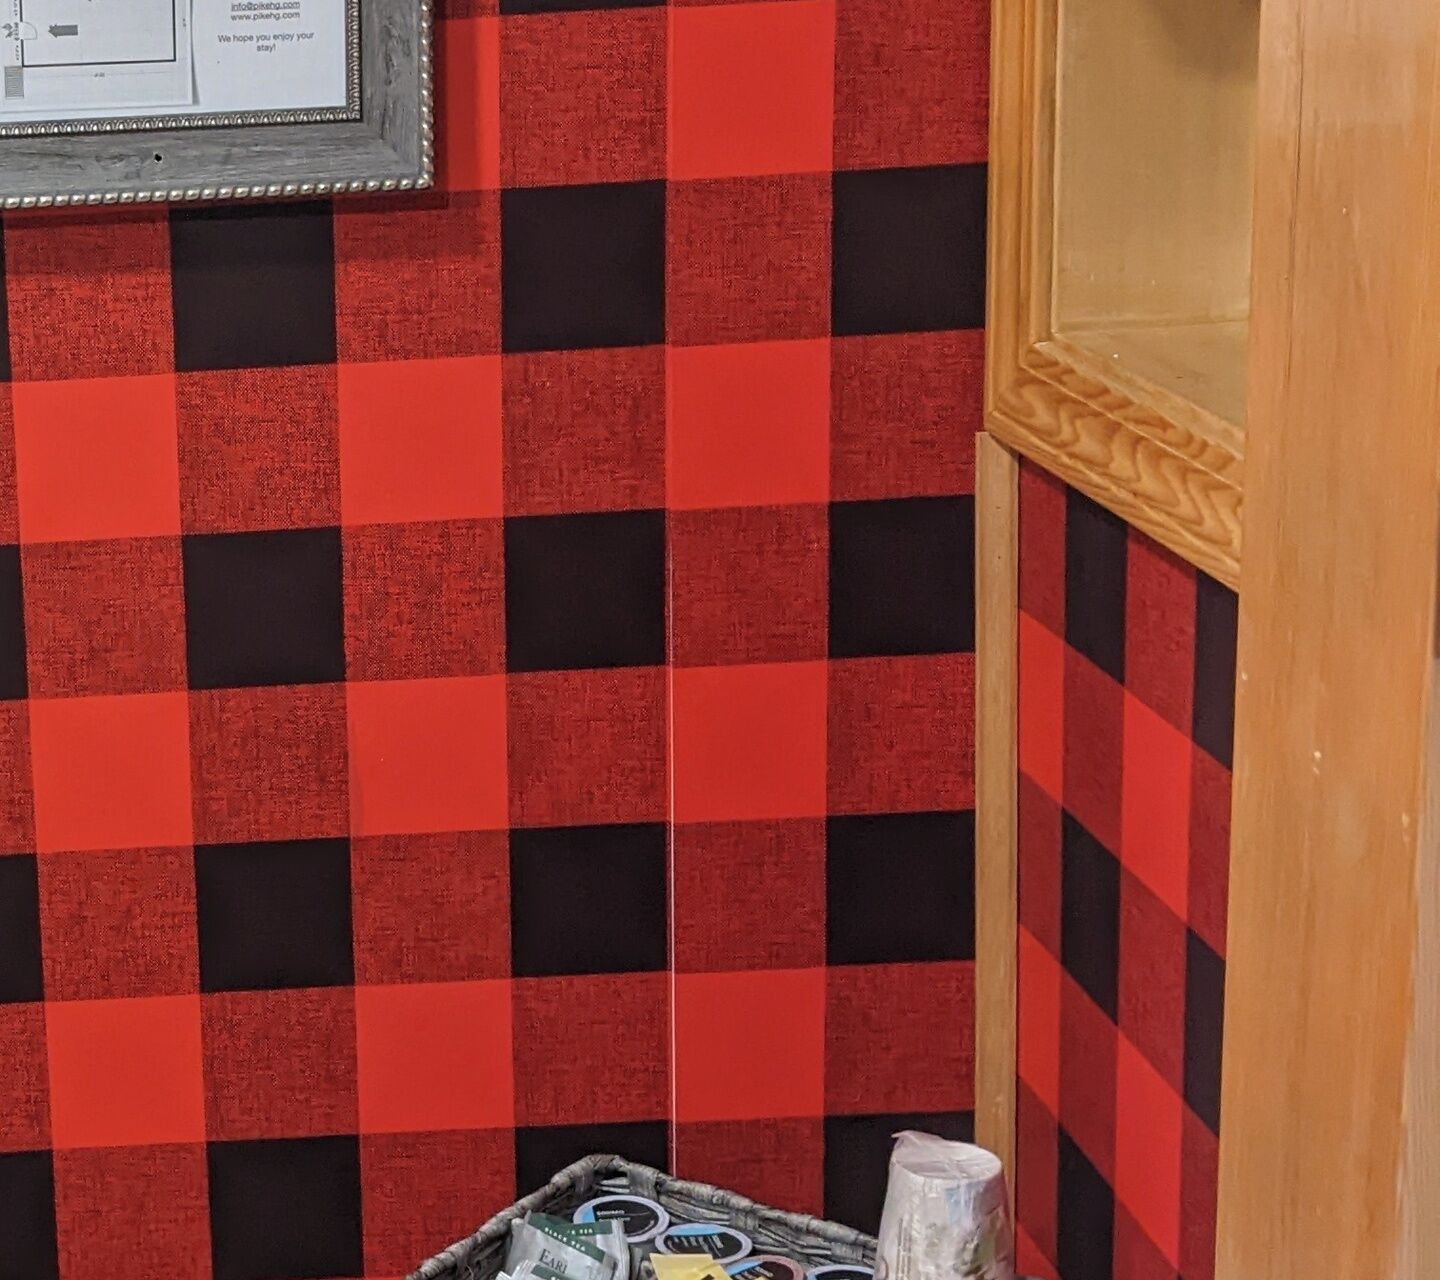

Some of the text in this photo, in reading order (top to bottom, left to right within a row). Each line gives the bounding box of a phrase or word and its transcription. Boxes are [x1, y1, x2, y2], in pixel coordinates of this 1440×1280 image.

[231, 1, 300, 12] info@pikehg.com
[231, 12, 300, 21] www.pikehg.com
[218, 33, 314, 43] We hope you enjoy your
[257, 44, 276, 53] stay!
[544, 1226, 586, 1252] BLACK TEA
